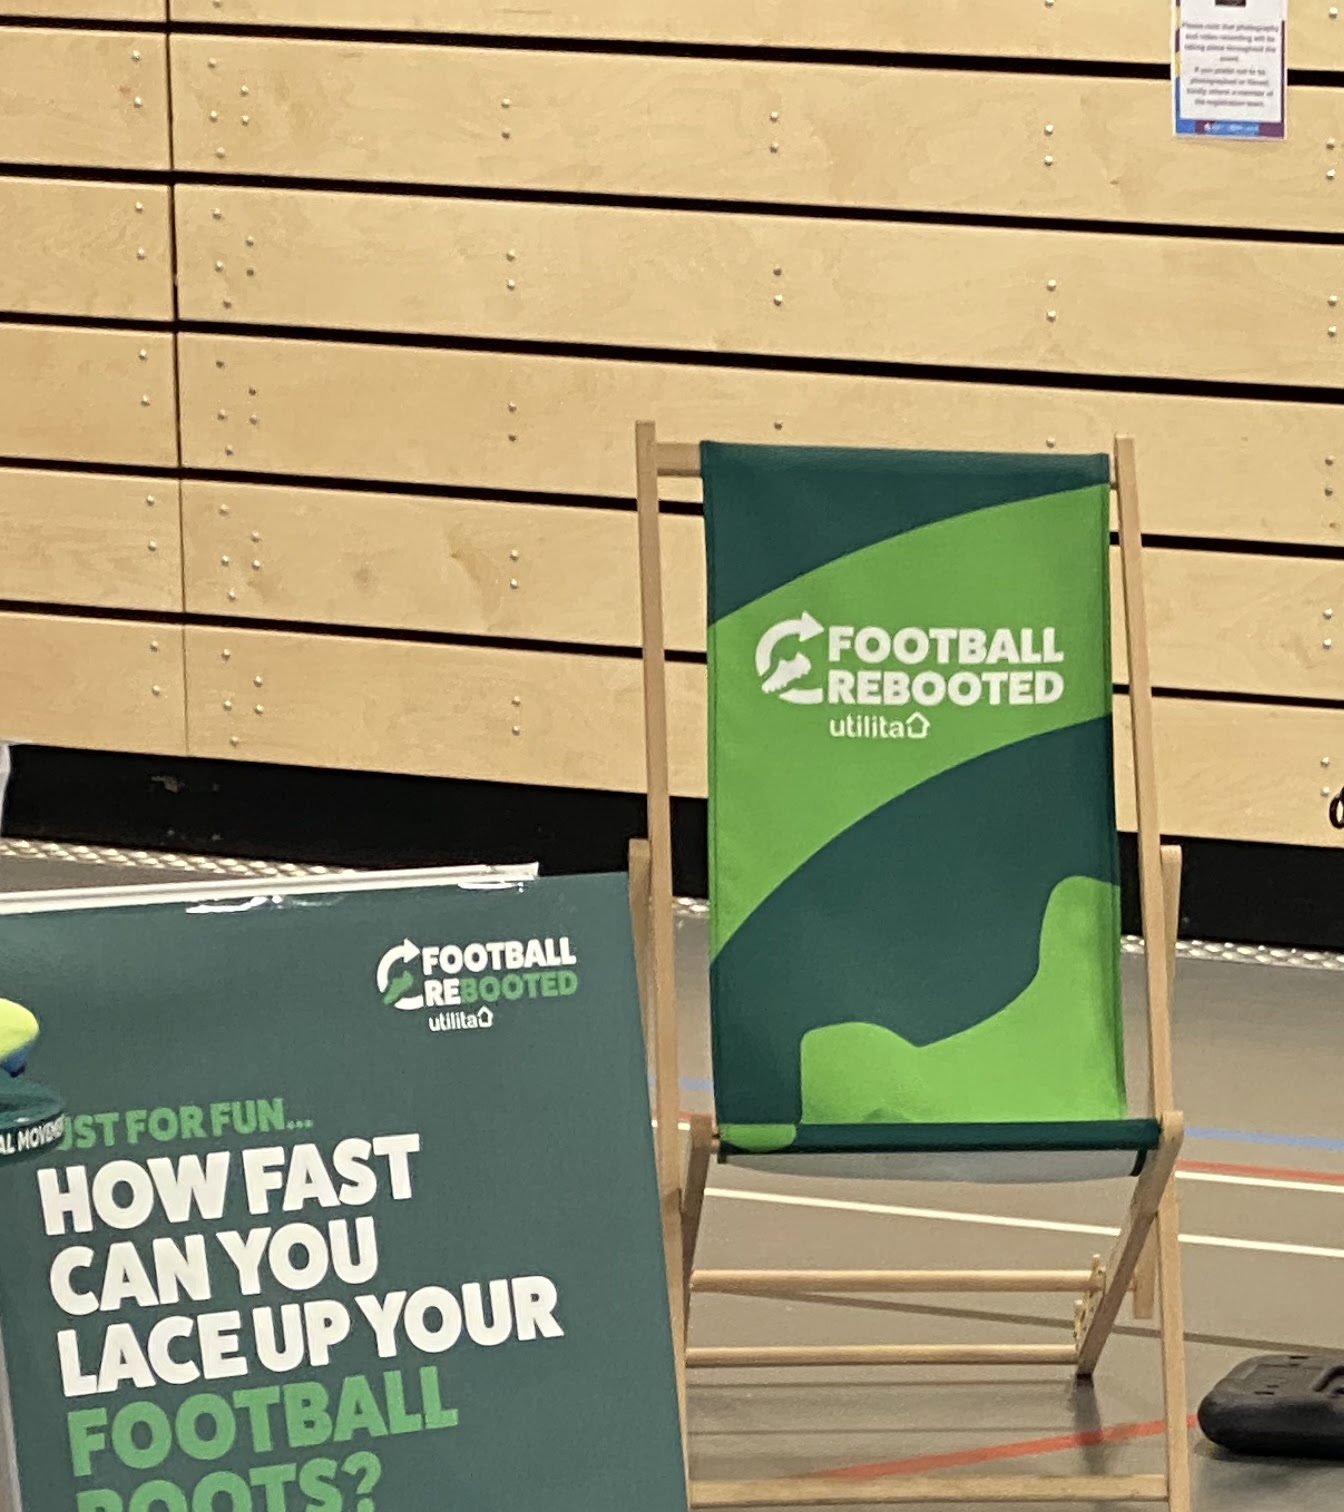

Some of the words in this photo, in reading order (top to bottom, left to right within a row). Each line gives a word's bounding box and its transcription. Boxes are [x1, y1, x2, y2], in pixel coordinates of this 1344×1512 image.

[828, 626, 1065, 665] FOOTBALL
[827, 669, 1065, 706] REBOOTED
[829, 713, 905, 738] utilita
[421, 936, 578, 976] FOOTBALL
[424, 969, 579, 1008] REBOOTED
[428, 1012, 479, 1032] utilita
[125, 1105, 207, 1145] FOR
[210, 1097, 315, 1138] FUN...
[37, 1150, 231, 1236] HOW
[242, 1133, 420, 1216] FAST
[49, 1233, 212, 1316] CAN
[216, 1216, 379, 1296] YOU
[57, 1310, 248, 1398] LACE
[252, 1299, 352, 1373] UP
[355, 1275, 565, 1358] YOUR
[67, 1365, 460, 1477] FOOTBALL
